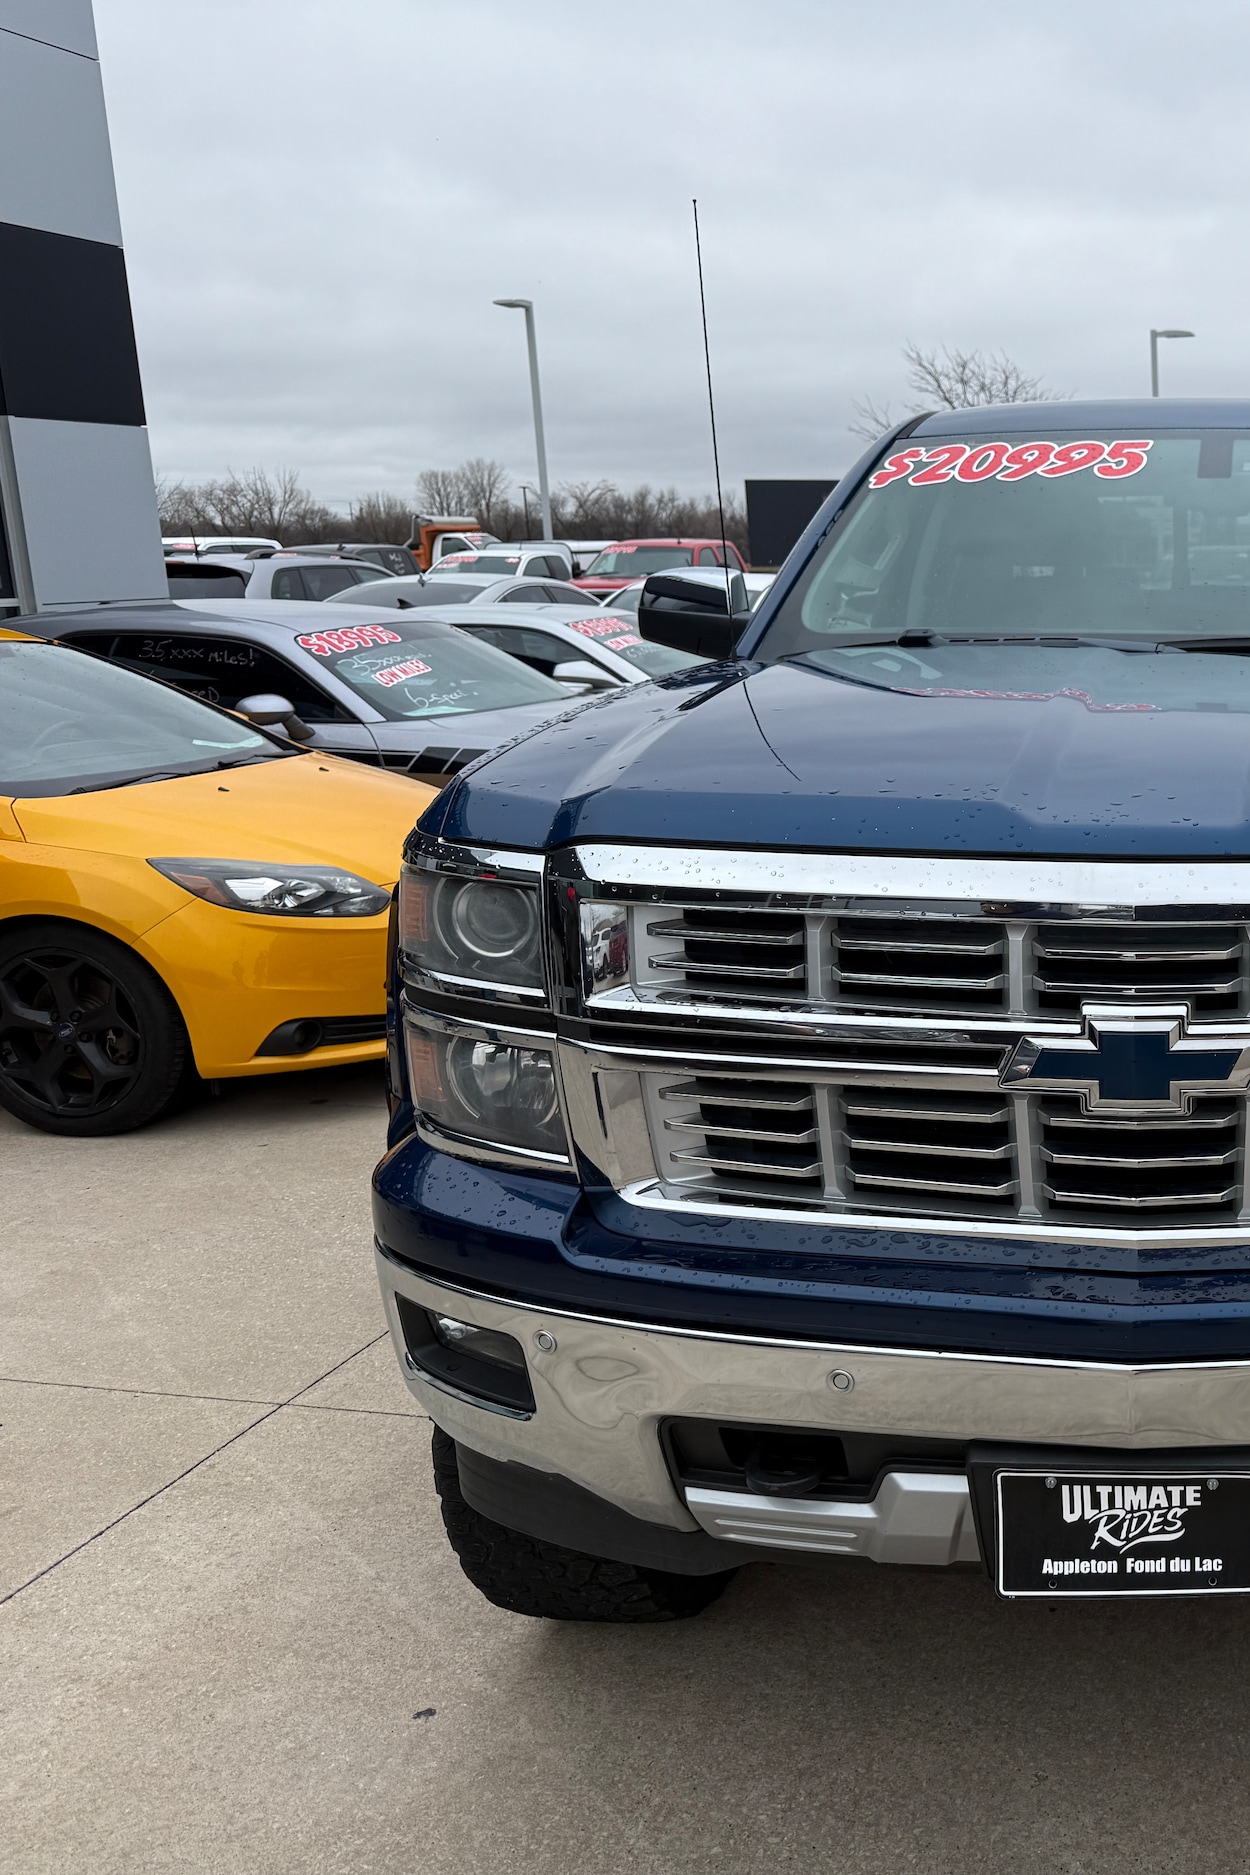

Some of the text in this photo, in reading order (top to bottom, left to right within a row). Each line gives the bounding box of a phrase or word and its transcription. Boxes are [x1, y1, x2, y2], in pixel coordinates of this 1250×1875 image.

[869, 440, 1154, 488] $20995
[298, 625, 402, 656] $18995
[371, 665, 403, 687] LOW
[1061, 1485, 1202, 1523] ULTIMATE
[1042, 1557, 1223, 1576] Appleton Fond du Lac
